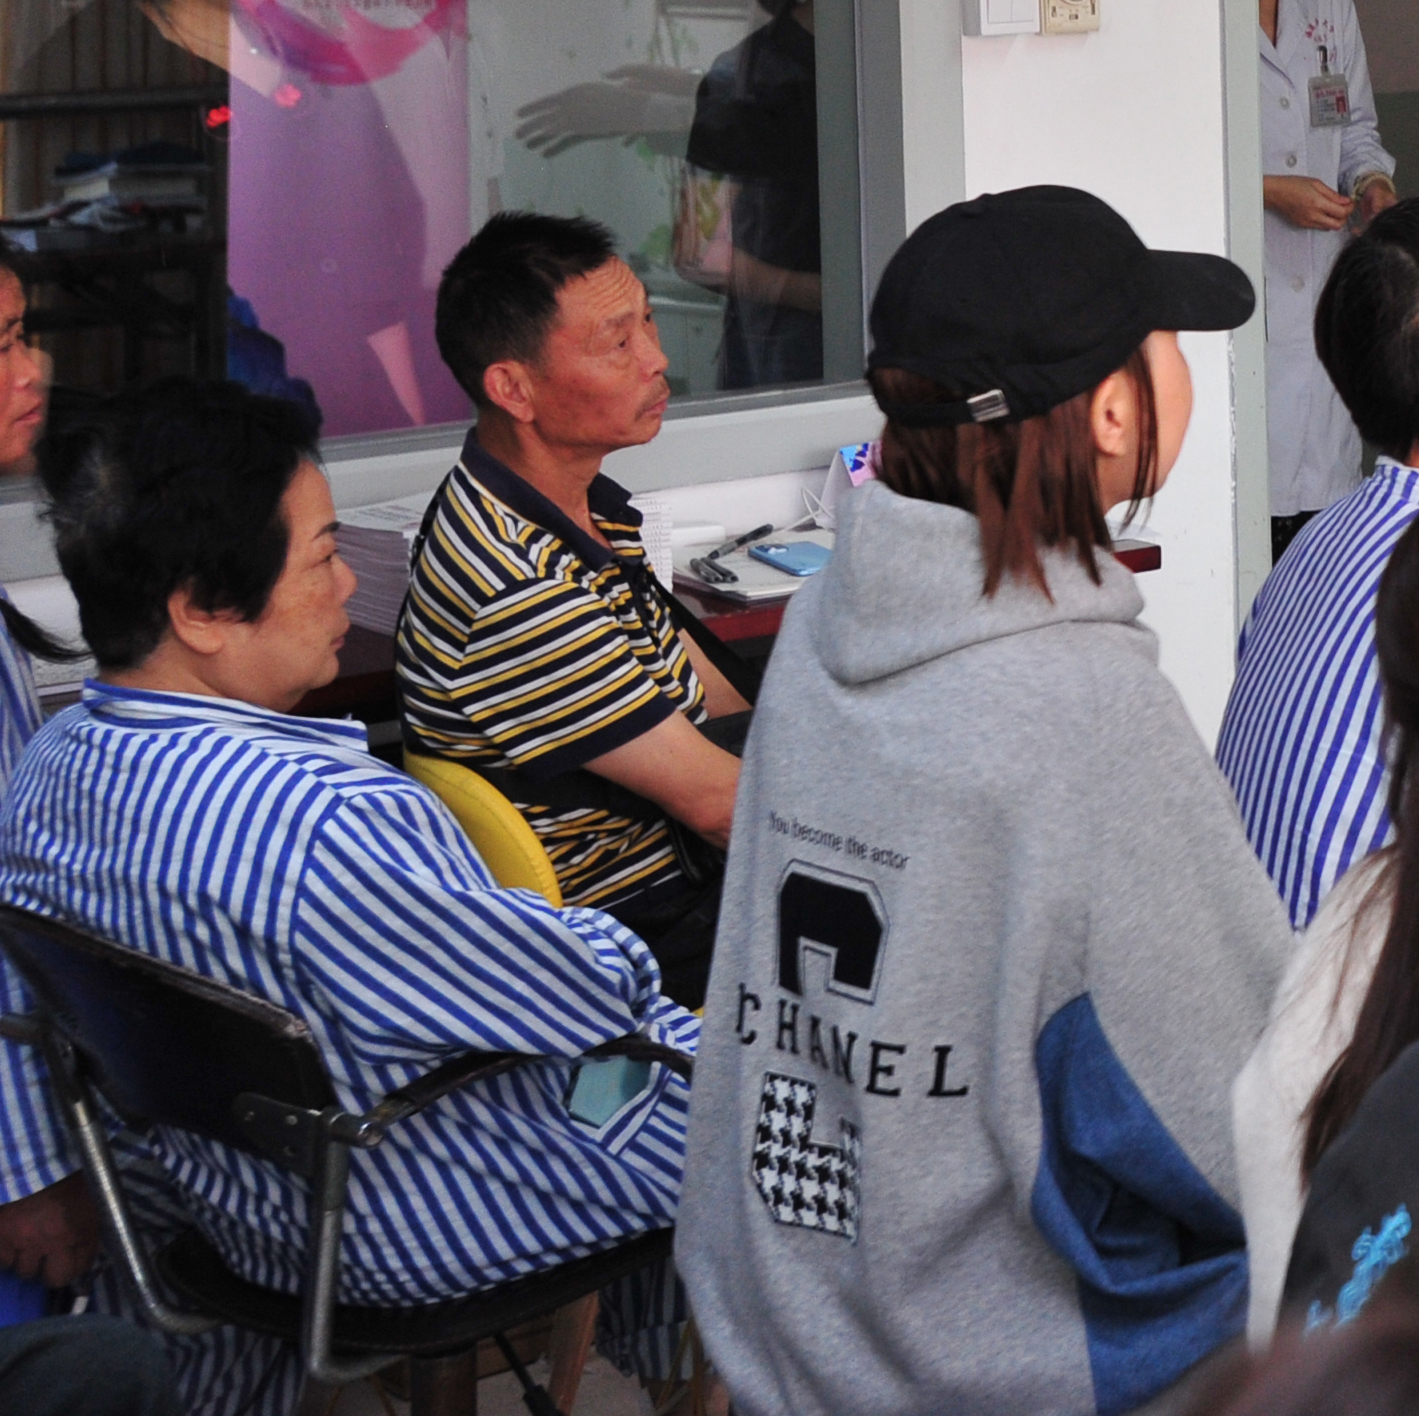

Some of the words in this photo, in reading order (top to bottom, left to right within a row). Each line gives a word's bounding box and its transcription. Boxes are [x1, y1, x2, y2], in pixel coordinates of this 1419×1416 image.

[768, 810, 790, 834] You
[791, 817, 843, 852] become
[845, 836, 869, 860] the
[870, 846, 911, 870] actor
